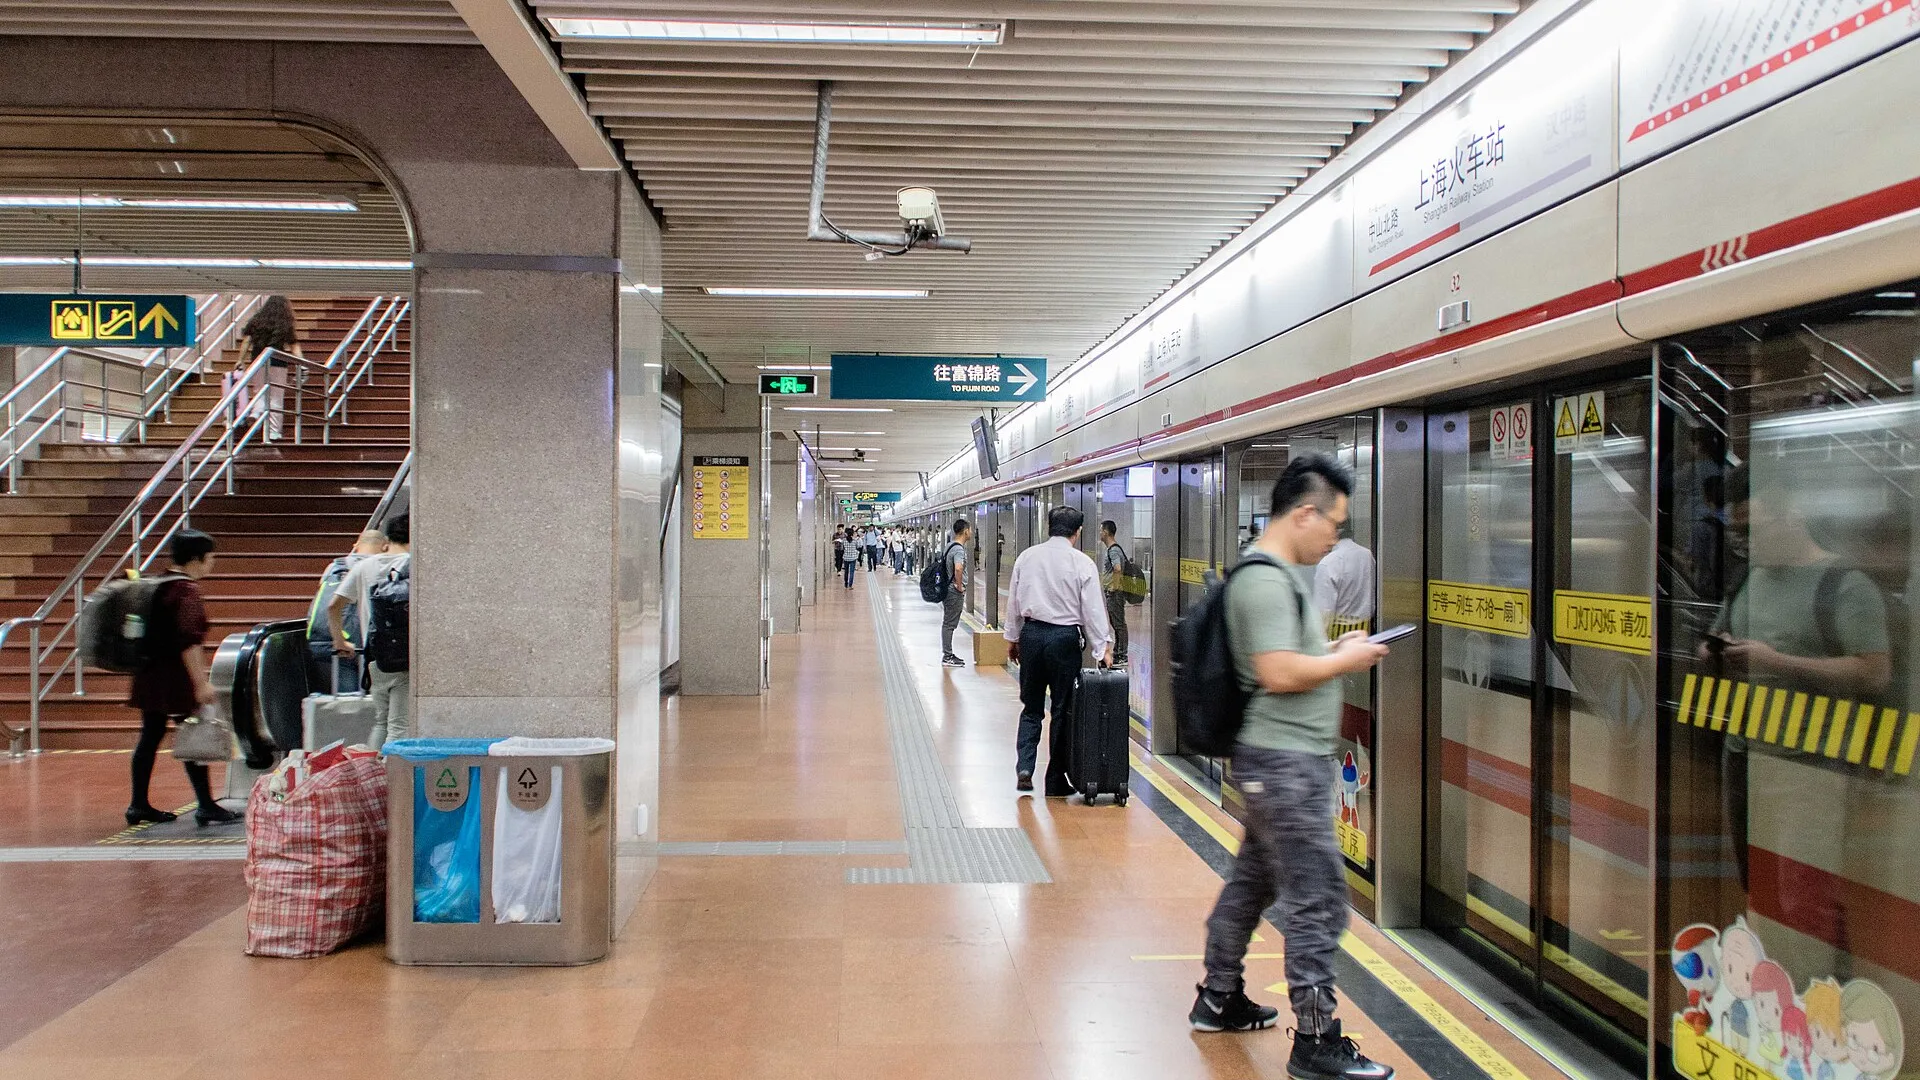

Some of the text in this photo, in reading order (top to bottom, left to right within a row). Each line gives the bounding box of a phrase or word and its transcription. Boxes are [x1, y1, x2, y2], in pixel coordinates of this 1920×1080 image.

[1414, 119, 1506, 211] 上海火车站
[1423, 177, 1494, 224] Shanghai Railway Station
[1368, 208, 1399, 242] 中山北路
[1451, 274, 1461, 293] 32
[933, 364, 1001, 382] 往富锦路
[1432, 590, 1524, 624] 宁等一列车 不抢一扇门
[1566, 604, 1651, 638] 门灯闪烁 请勿
[1423, 1002, 1513, 1077] Please mind the gap
